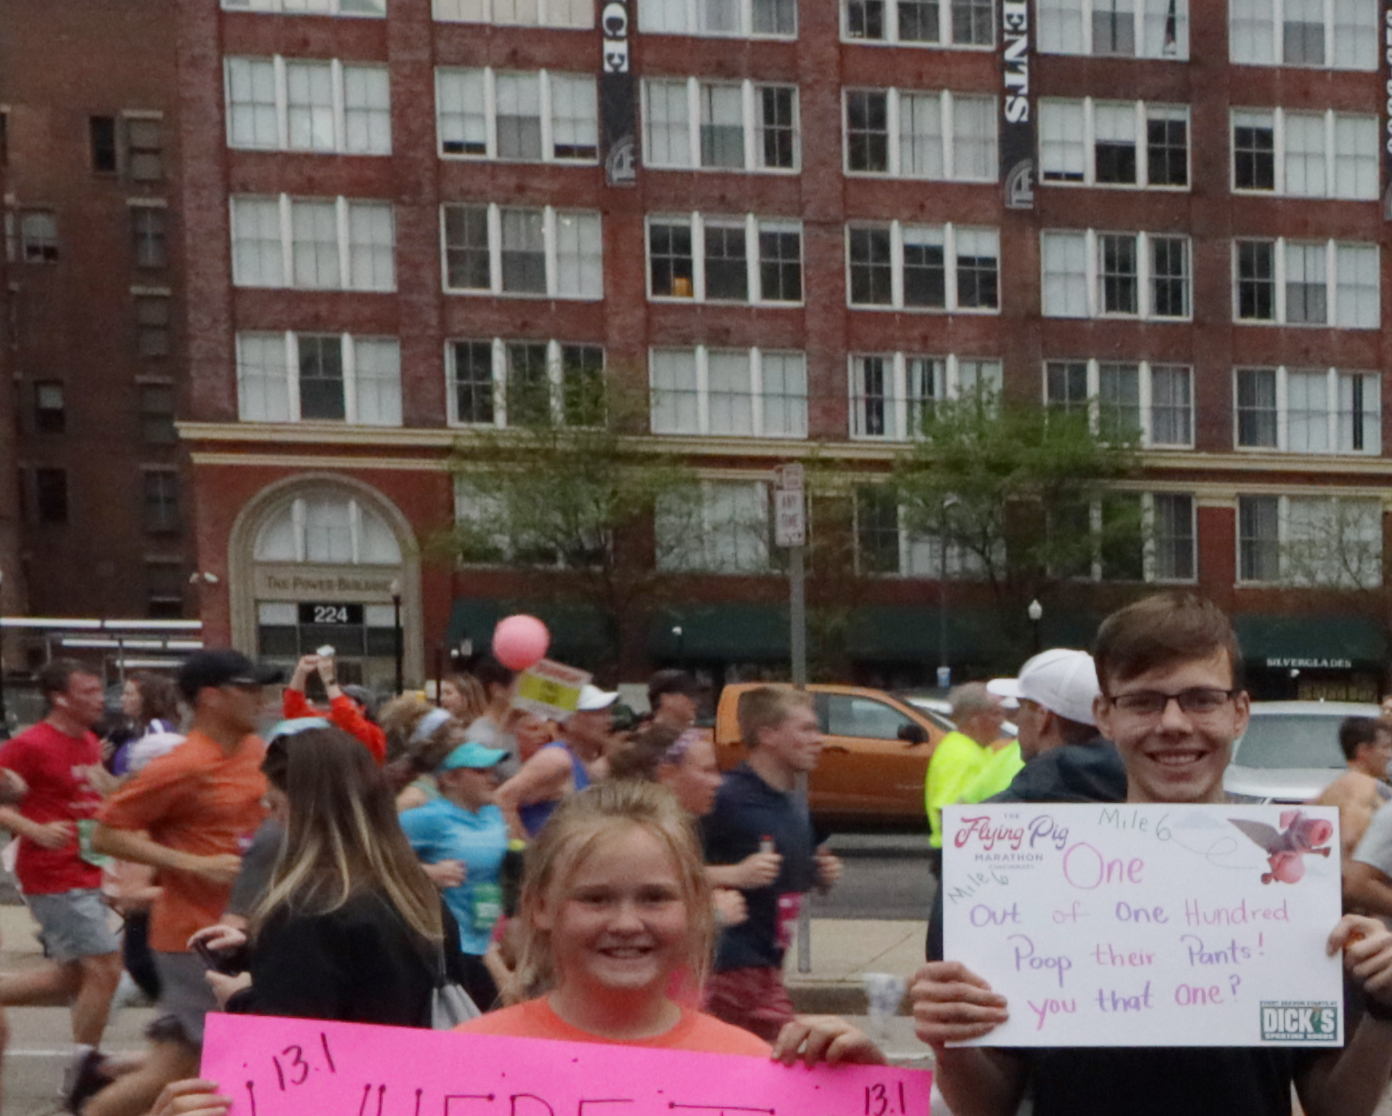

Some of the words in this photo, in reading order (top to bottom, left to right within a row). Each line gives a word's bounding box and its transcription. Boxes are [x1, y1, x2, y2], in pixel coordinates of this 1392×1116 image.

[314, 605, 348, 623] 224
[1266, 657, 1352, 669] SILVERGLADES
[954, 816, 1024, 850] Flying
[1028, 814, 1069, 850] Pig
[1099, 807, 1148, 832] Mile
[1155, 812, 1172, 841] 6
[974, 852, 1044, 862] MARATHON
[1063, 842, 1144, 890] One
[947, 869, 990, 905] Mile
[969, 902, 1021, 927] Out
[1052, 902, 1088, 924] of
[1185, 899, 1290, 926] Hundred
[1007, 934, 1073, 988] Poop
[1090, 942, 1156, 967] their
[1180, 932, 1266, 967] Pants!
[1027, 997, 1077, 1031] you
[1094, 980, 1154, 1013] that
[272, 1033, 336, 1092] 13.1
[864, 1080, 906, 1116] 13.1
